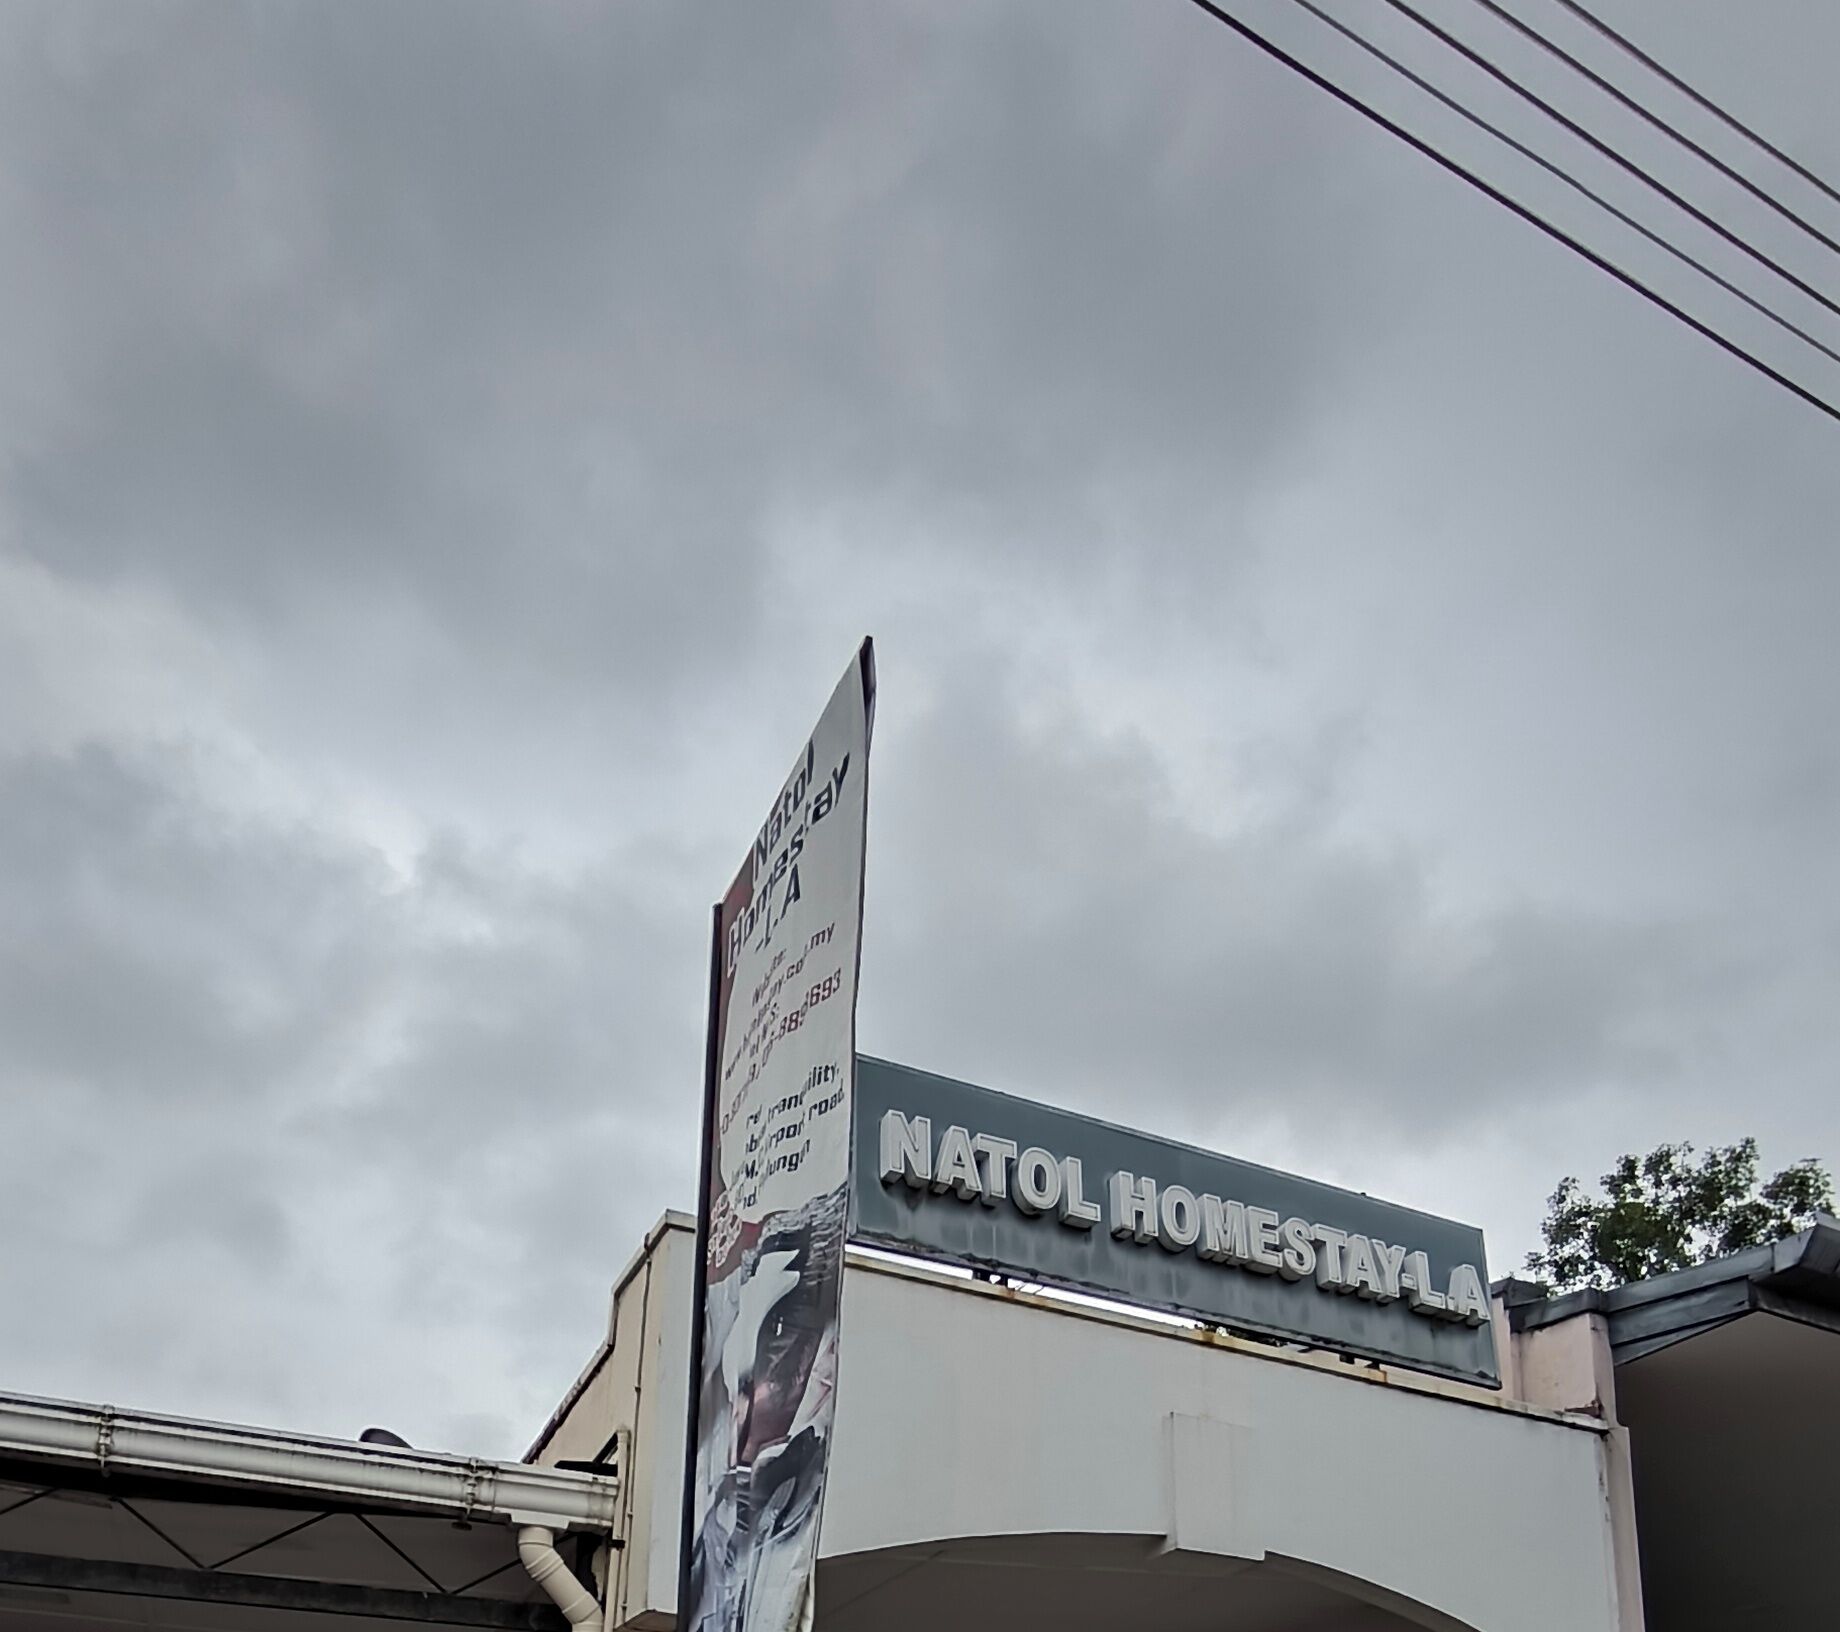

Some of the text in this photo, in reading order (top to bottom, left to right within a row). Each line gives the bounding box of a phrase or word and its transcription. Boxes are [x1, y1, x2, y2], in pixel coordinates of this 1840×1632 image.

[727, 752, 850, 978] Homestay
[752, 737, 814, 882] Natol
[879, 1108, 1101, 1229] NATOL
